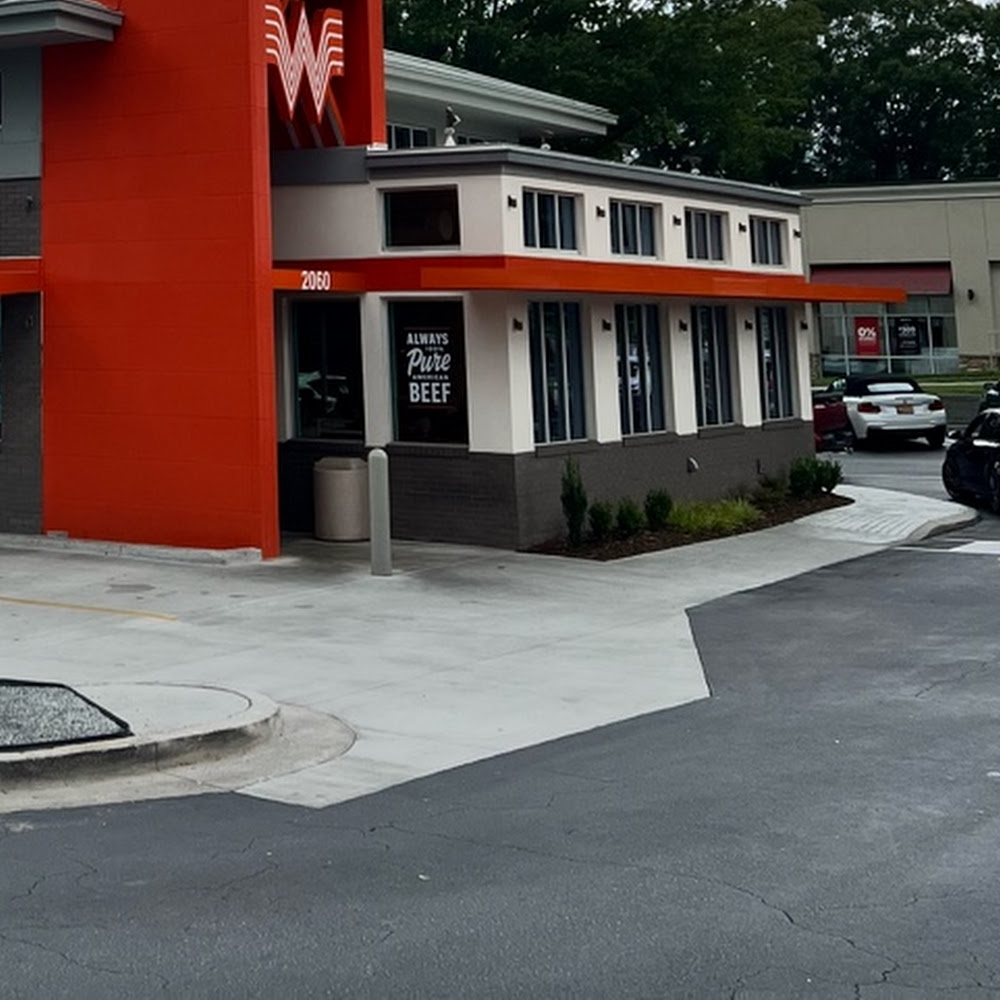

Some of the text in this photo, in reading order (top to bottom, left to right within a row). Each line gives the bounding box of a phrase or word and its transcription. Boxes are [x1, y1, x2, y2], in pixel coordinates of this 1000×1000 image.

[301, 270, 331, 290] 2060
[406, 332, 449, 345] ALWAYS
[406, 347, 452, 377] Pure
[409, 382, 451, 403] BEEF
